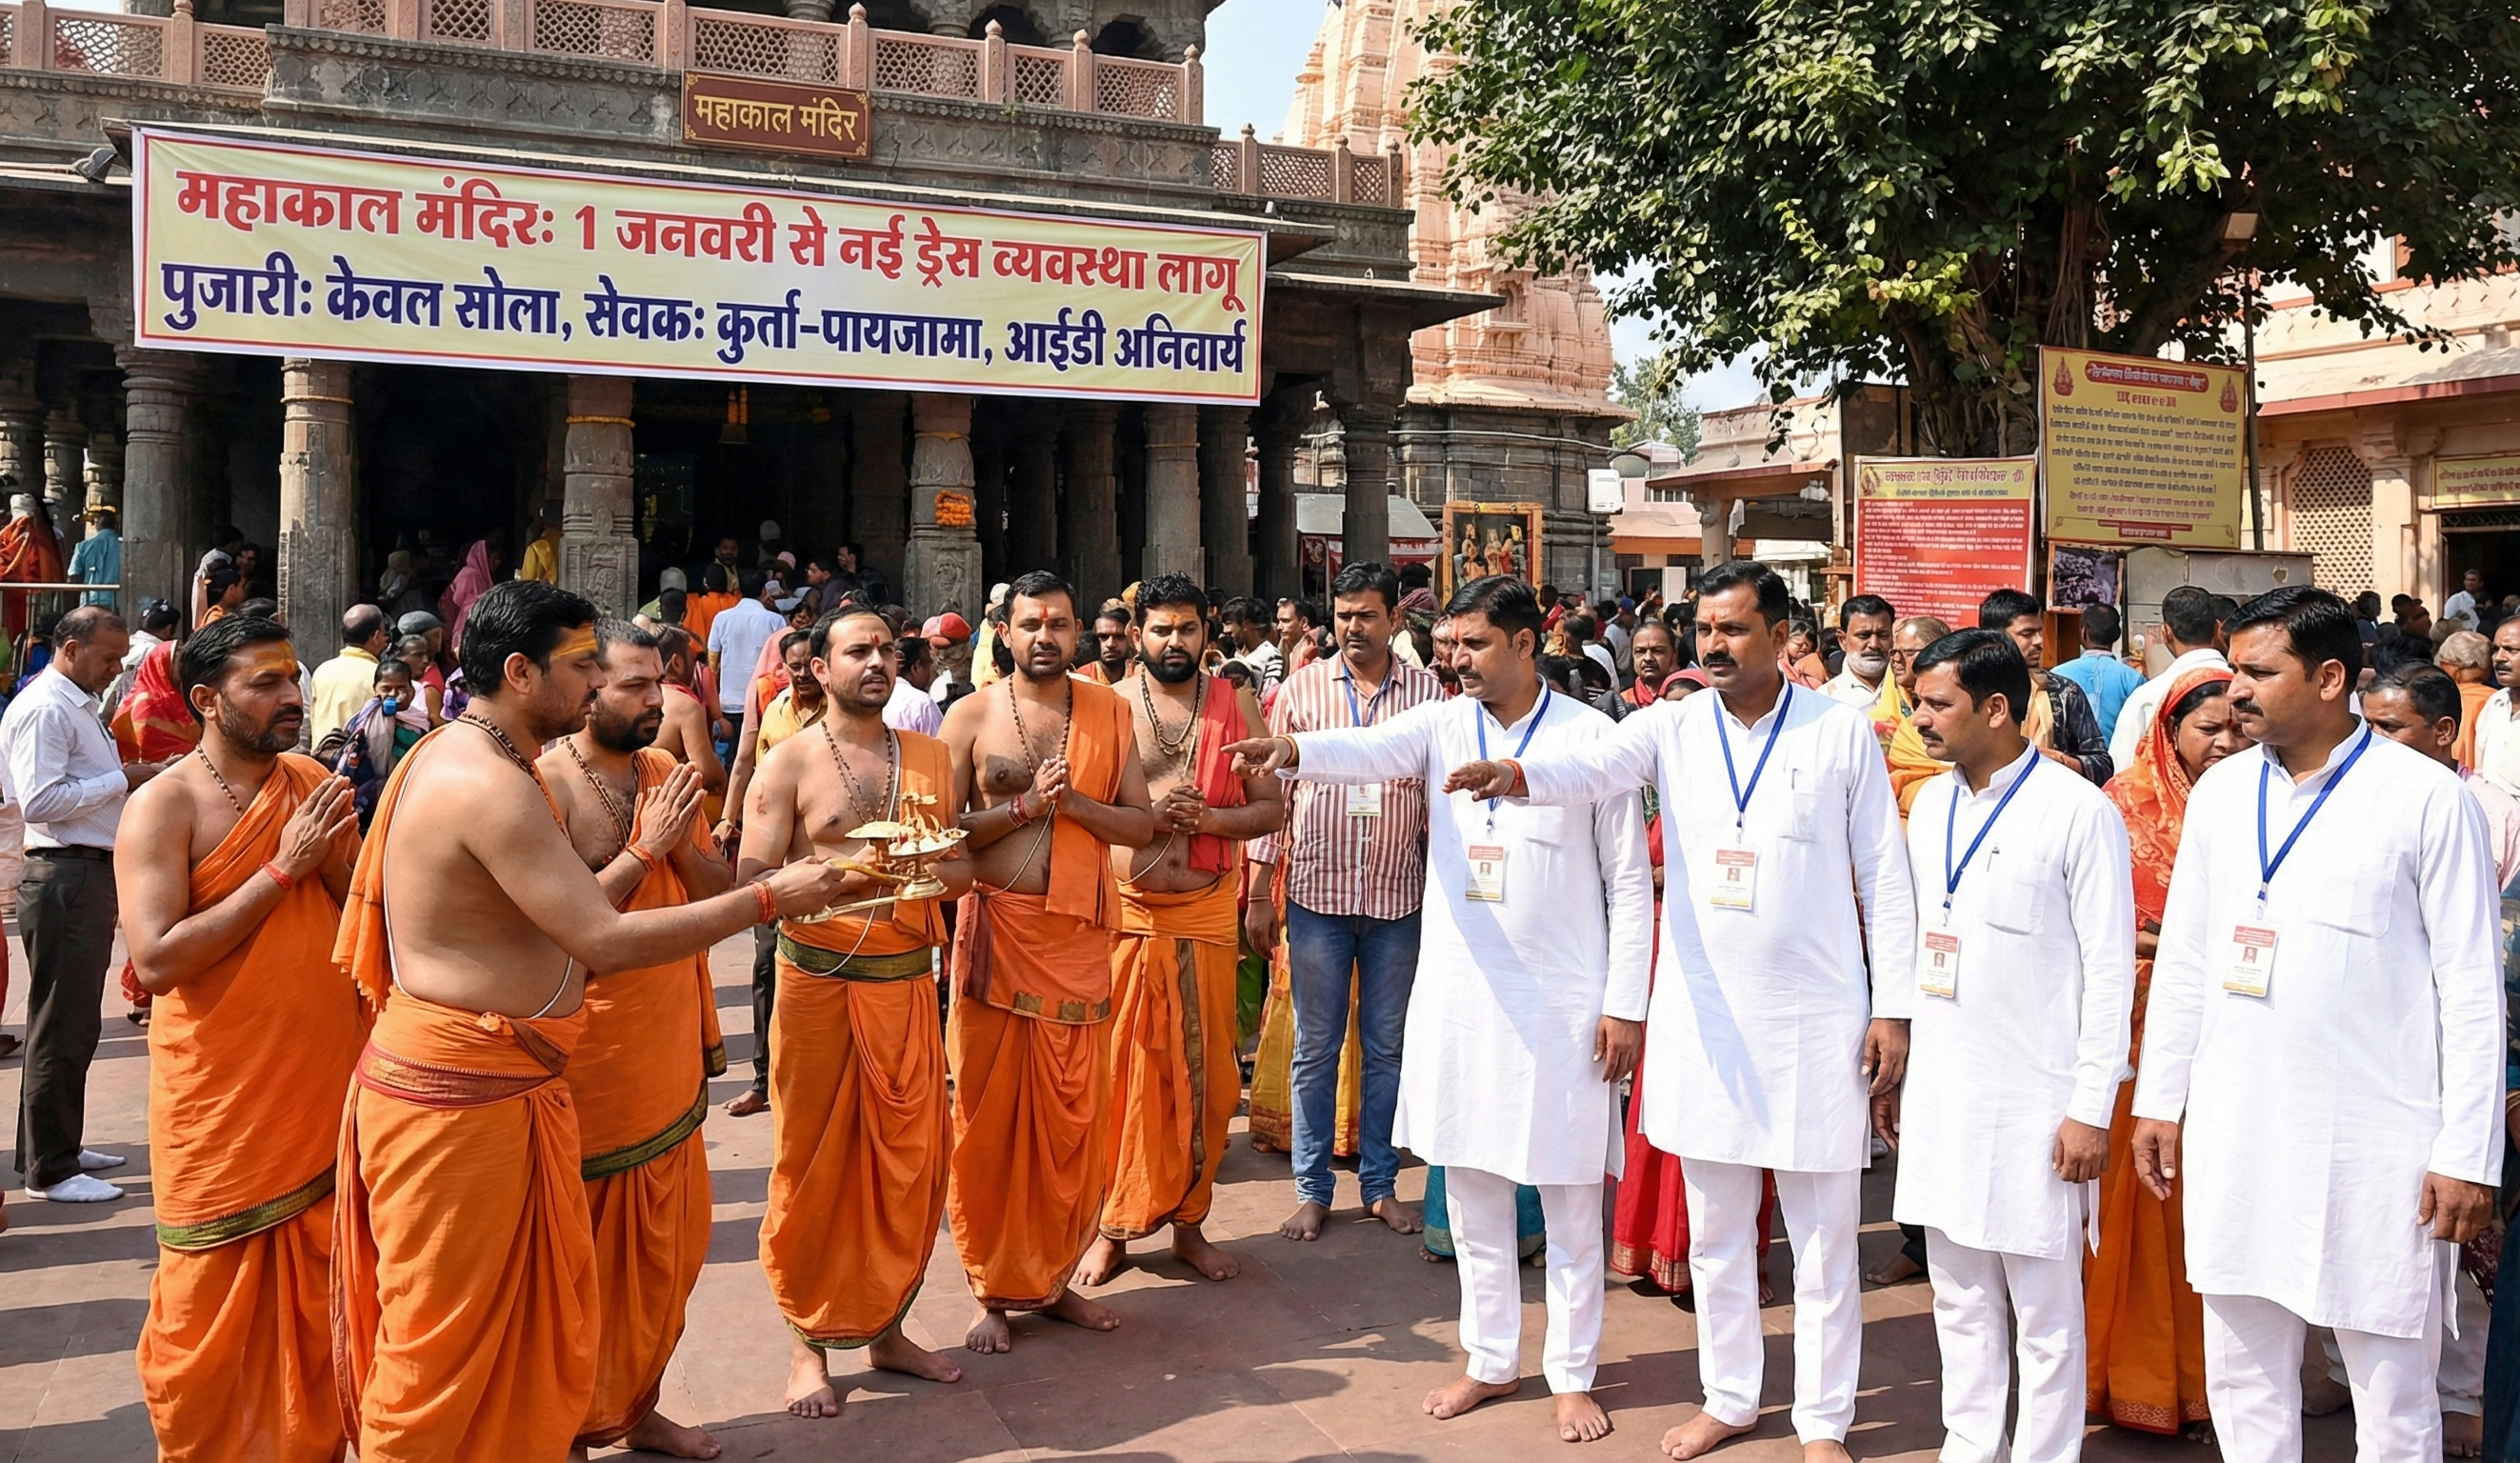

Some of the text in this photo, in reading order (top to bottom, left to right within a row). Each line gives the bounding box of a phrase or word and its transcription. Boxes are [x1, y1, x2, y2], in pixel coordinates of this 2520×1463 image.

[693, 94, 859, 142] महाकाल मंदिर
[177, 170, 402, 233] महाकाल
[576, 206, 595, 250] 1
[616, 202, 776, 263] जनवरी
[790, 206, 828, 267] से
[839, 214, 905, 279] नई
[914, 216, 982, 287] ड्रेस
[992, 241, 1148, 290] व्यवस्था
[1158, 253, 1246, 312] लागू
[326, 254, 444, 327] केवल
[453, 266, 572, 341] सोला,
[716, 289, 992, 365] कुर्ता-पायजामा,
[1006, 307, 1107, 371] आईडी
[1114, 313, 1246, 372] अनिवार्य
